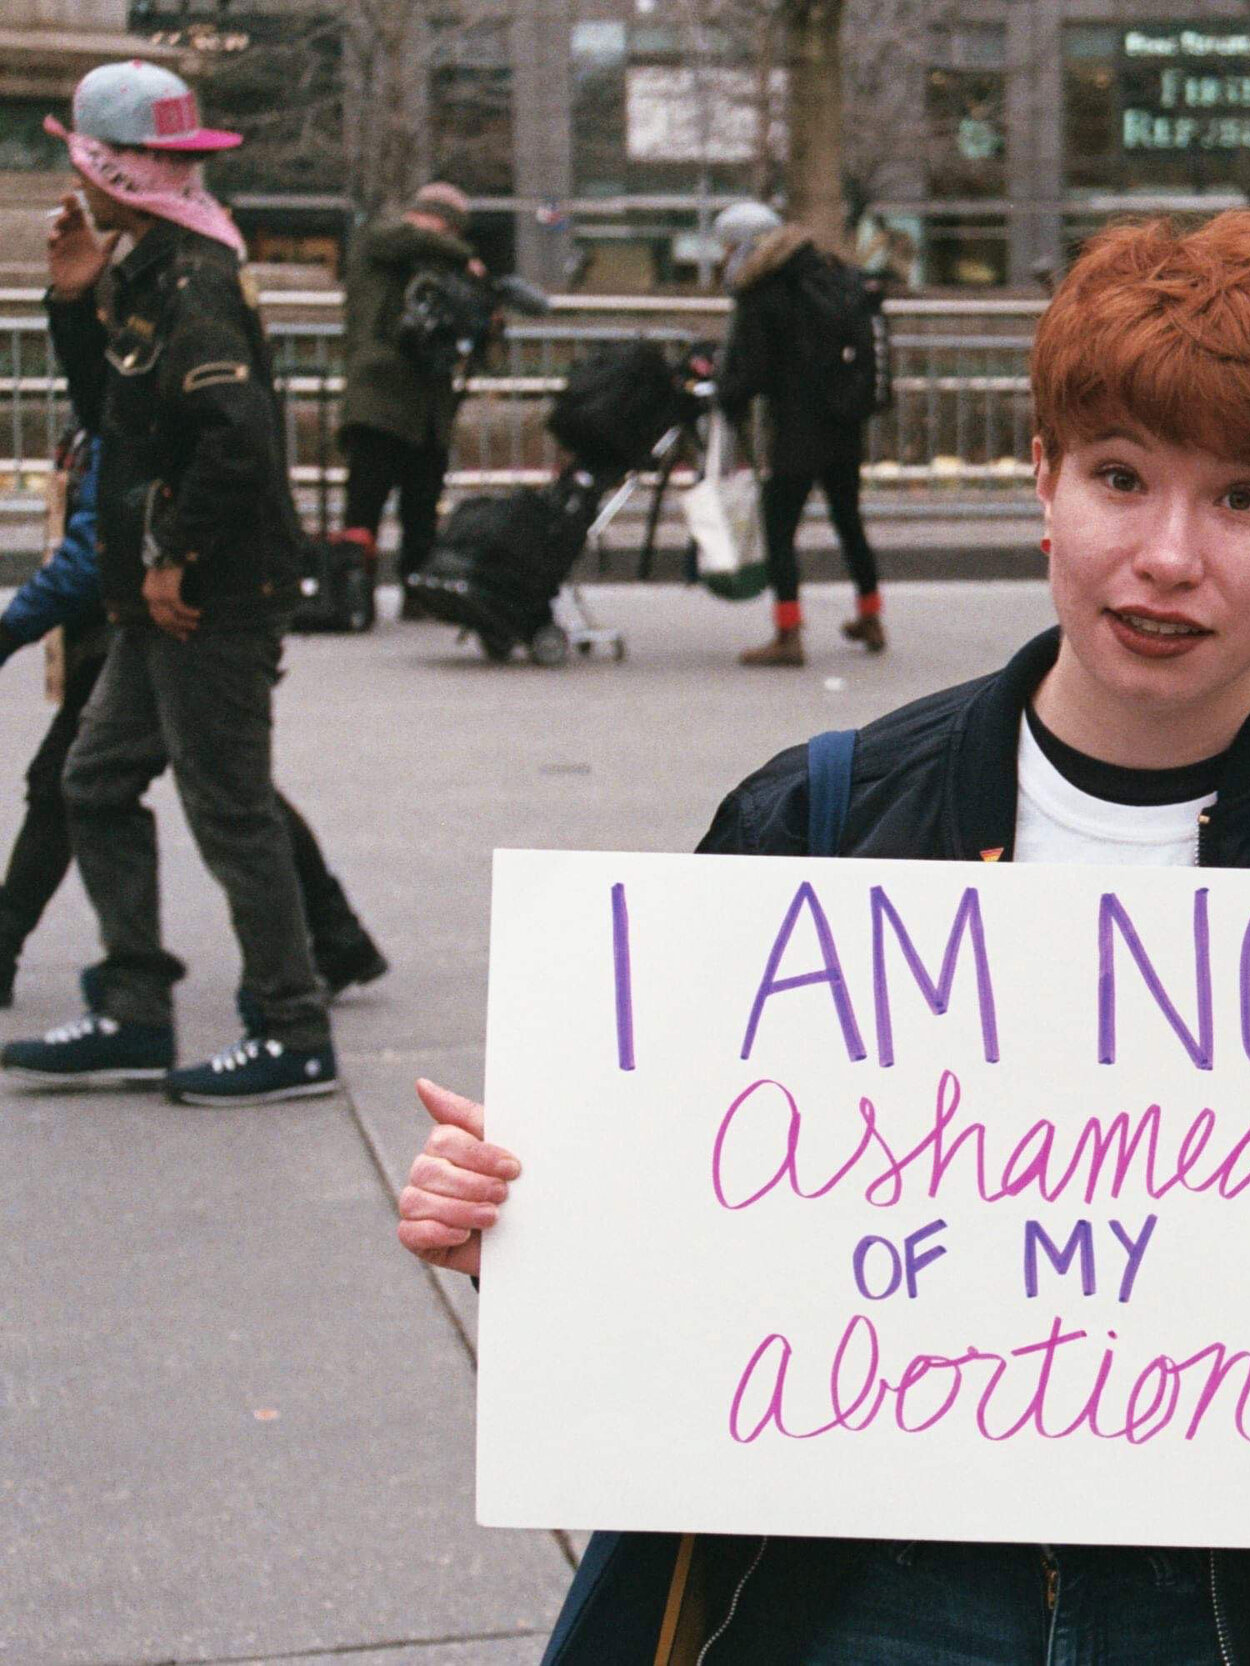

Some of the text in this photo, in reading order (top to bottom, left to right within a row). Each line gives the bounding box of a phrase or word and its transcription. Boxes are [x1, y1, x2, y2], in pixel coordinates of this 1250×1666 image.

[612, 884, 634, 1070] I
[741, 882, 998, 1067] AM
[854, 1215, 1156, 1302] OF MY
